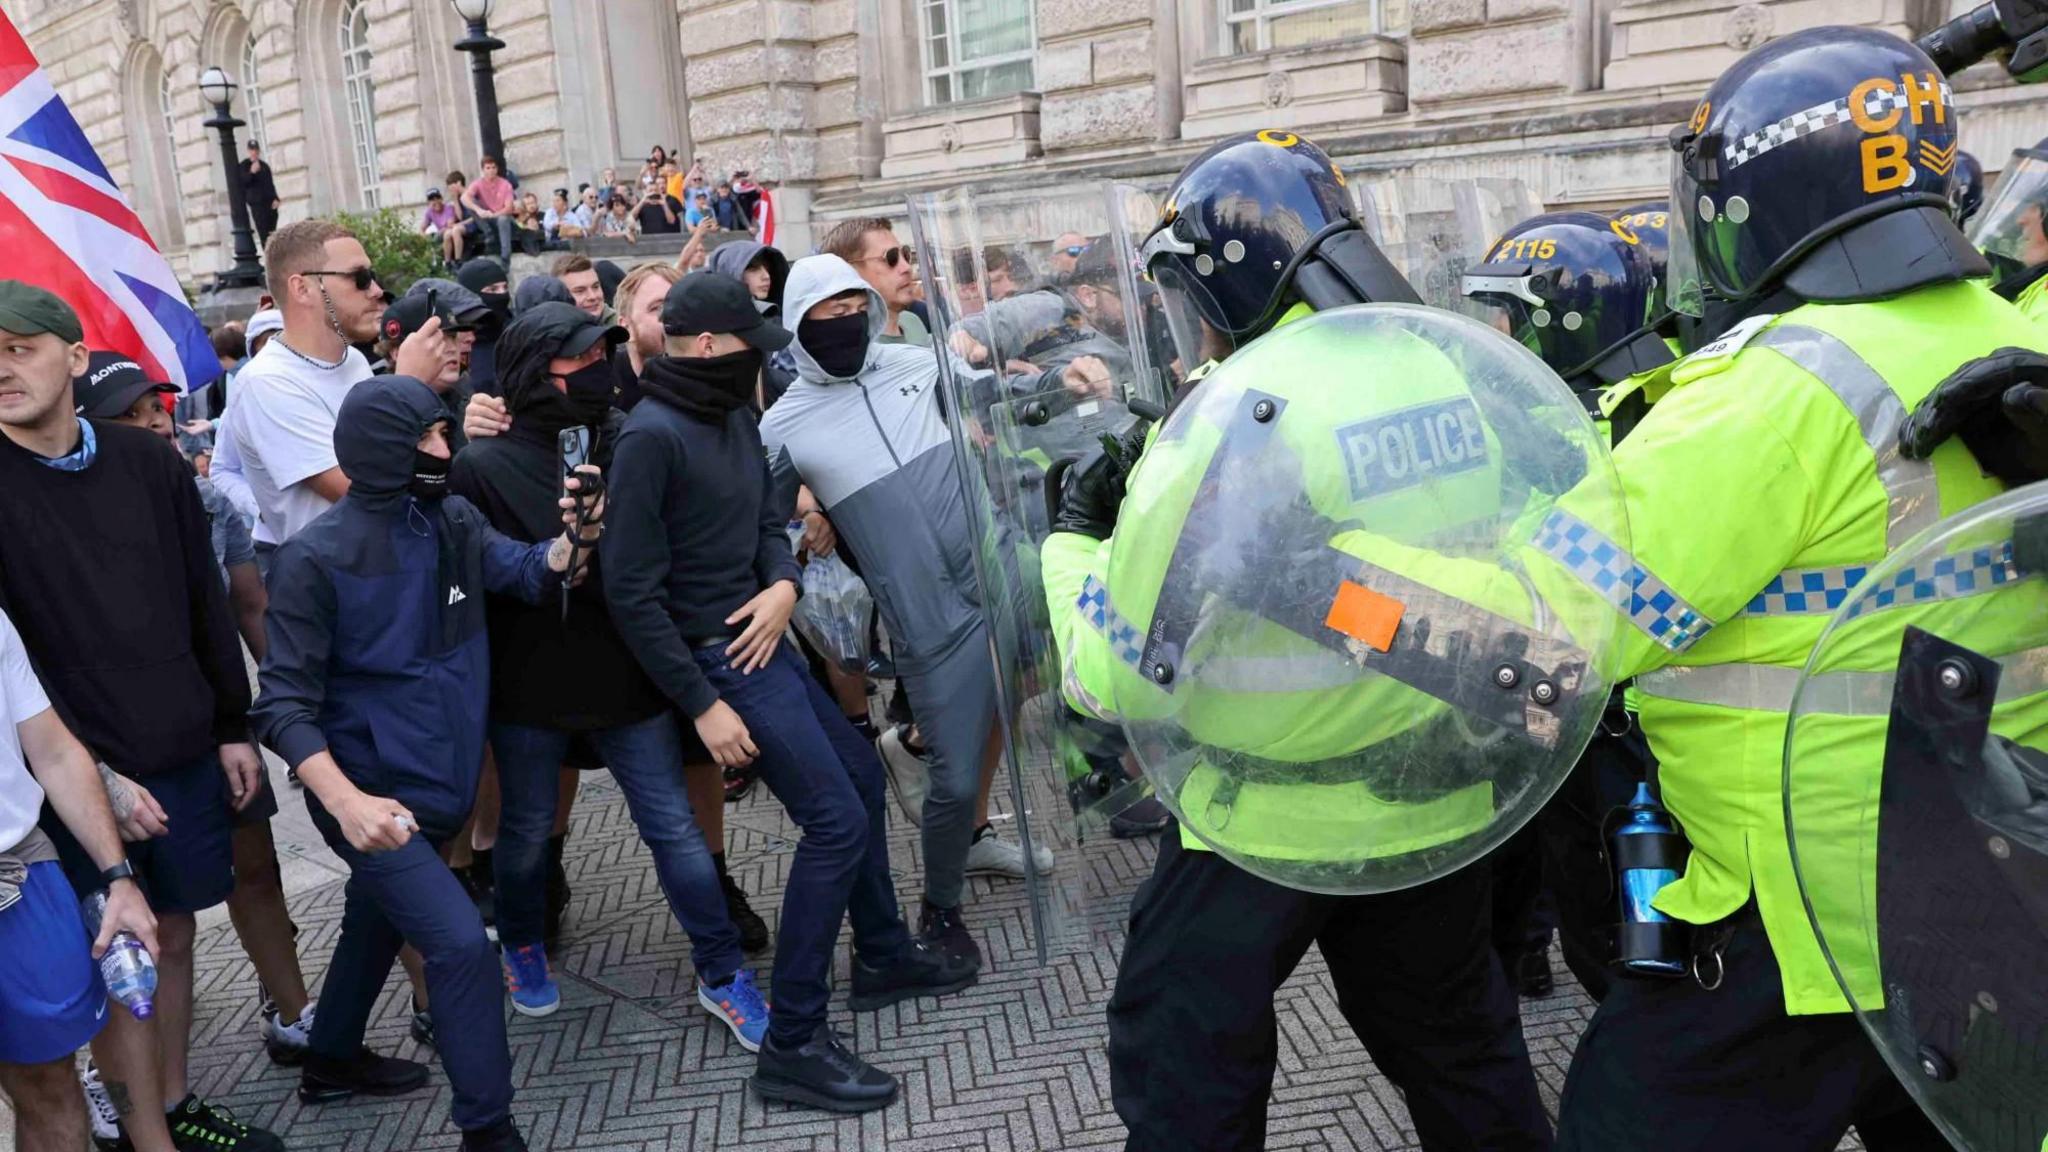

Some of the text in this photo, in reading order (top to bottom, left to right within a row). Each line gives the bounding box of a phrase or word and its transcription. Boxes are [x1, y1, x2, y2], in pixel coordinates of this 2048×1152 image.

[1860, 134, 1911, 194] B
[1496, 239, 1558, 261] 2115
[1347, 408, 1483, 490] POLICE
